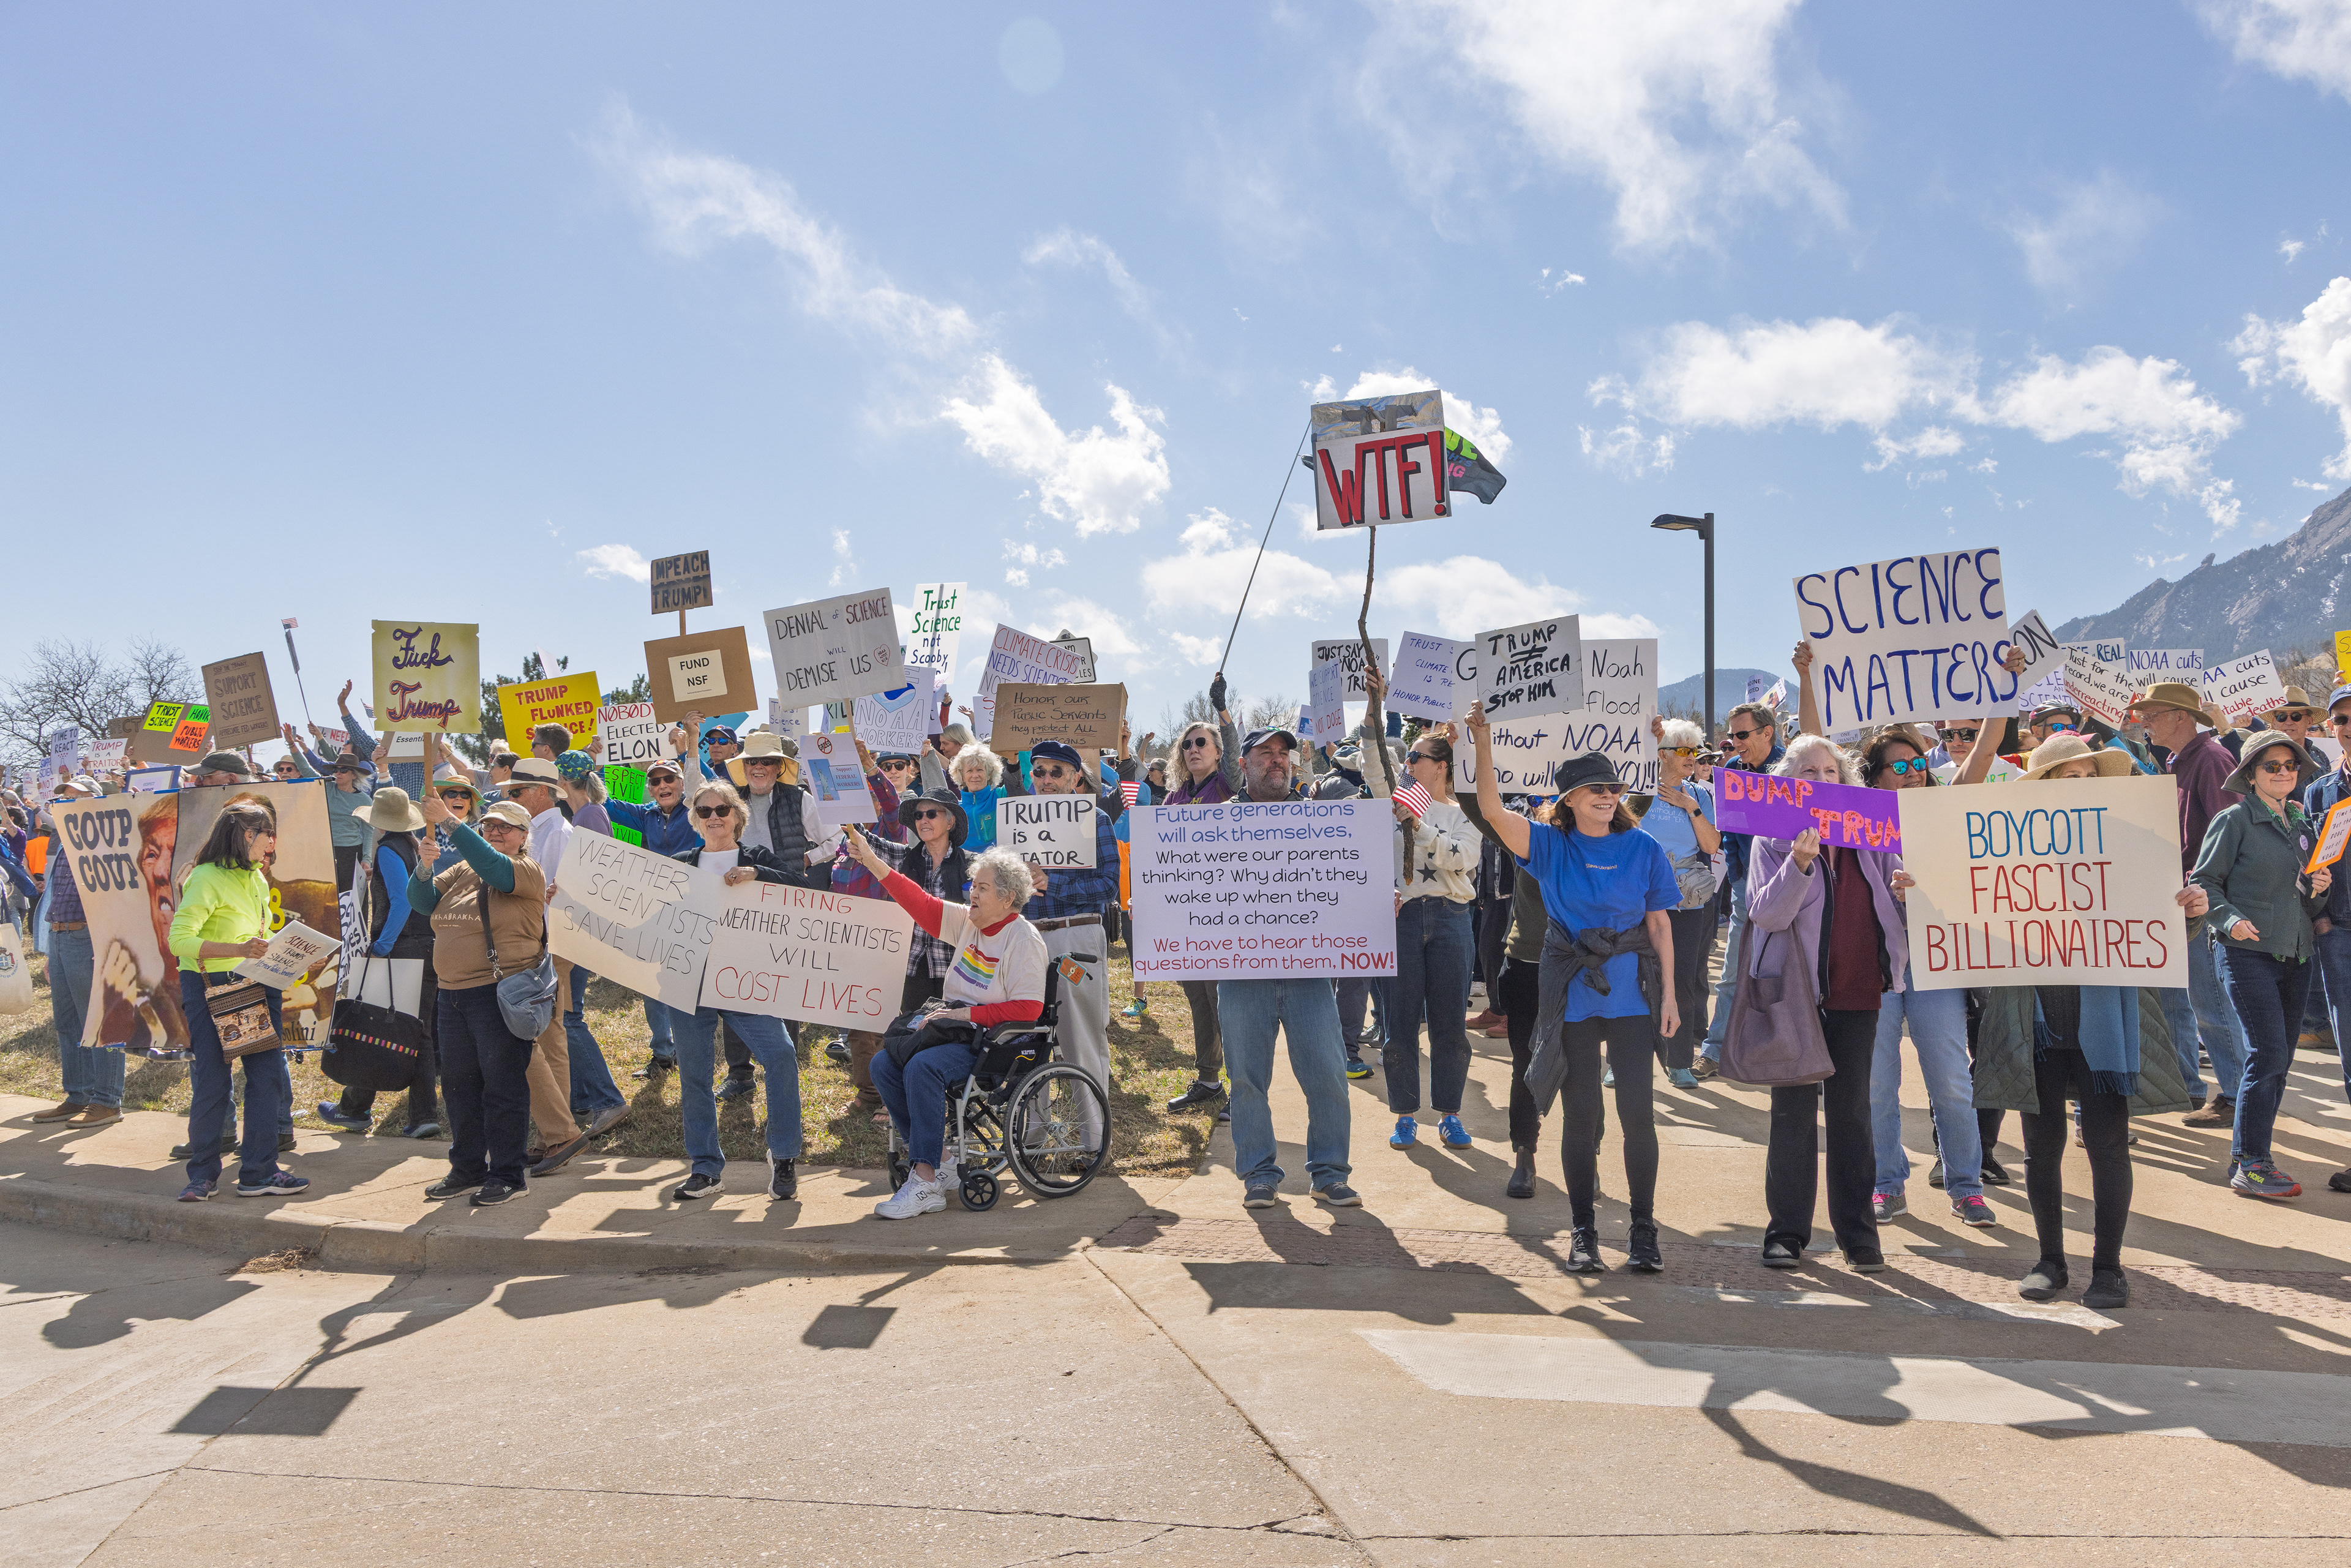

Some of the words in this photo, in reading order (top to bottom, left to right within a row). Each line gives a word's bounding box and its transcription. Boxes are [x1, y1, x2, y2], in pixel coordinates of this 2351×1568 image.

[1318, 430, 1447, 527] WTF!
[924, 589, 957, 610] Trust
[1797, 548, 2003, 639] SCIENCE
[775, 610, 829, 640] DENIAL
[833, 609, 839, 620] of
[846, 596, 889, 625] SCIENCE
[912, 612, 961, 634] Science
[392, 625, 455, 670] Fuck
[827, 647, 847, 655] WILL
[923, 634, 940, 647] not
[994, 628, 1046, 663] CLIMATE
[1046, 647, 1079, 674] CRISIS
[1410, 638, 1442, 651] TRUST
[1487, 624, 1558, 656] TRUMP
[910, 649, 948, 667] Scooby
[1318, 644, 1344, 661] JUST
[1343, 642, 1365, 658] SAY
[1592, 645, 1643, 678] Noah
[2096, 643, 2125, 662] REAL
[2130, 651, 2169, 670] NOAA
[2177, 650, 2202, 670] cuts
[680, 657, 710, 670] FUND
[786, 661, 838, 691] DEMISE
[850, 654, 871, 675] US
[988, 650, 1021, 678] NEEDS
[1319, 663, 1339, 685] SUPPORT
[1415, 659, 1449, 673] CLIMATE
[1496, 653, 1570, 686] AMERICA
[2068, 646, 2087, 667] Just
[2091, 661, 2109, 673] for
[2113, 672, 2134, 692] the
[2236, 655, 2270, 673] cuts
[214, 672, 257, 698] SUPPORT
[687, 675, 708, 687] NSF
[1824, 640, 2018, 727] MATTERS
[2065, 664, 2093, 687] record,
[2093, 680, 2106, 692] we
[2109, 688, 2129, 703] are
[2221, 674, 2268, 698] cause
[386, 680, 462, 730] Trump
[515, 685, 568, 705] TRUMP
[1313, 686, 1335, 708] SCIENCE
[1393, 688, 1420, 703] HONOR
[1485, 688, 1524, 714] STOP
[1528, 679, 1556, 702] HIM
[1585, 690, 1640, 715] flood
[2063, 678, 2124, 724] underreacting
[157, 705, 181, 716] TRUST
[220, 695, 264, 720] SCIENCE
[855, 698, 924, 730] NOAA
[2245, 696, 2287, 718] deaths
[148, 717, 176, 727] SCIENCE
[607, 722, 667, 740] ELECTED
[770, 715, 800, 725] Science
[1010, 724, 1029, 735] they
[1074, 723, 1098, 733] ALL
[1316, 716, 1324, 735] NOT
[1327, 708, 1341, 729] DOGE
[53, 732, 68, 743] TIME
[70, 728, 78, 738] TO
[175, 736, 201, 748] WORKERS
[182, 726, 205, 737] PUBLIC
[1562, 723, 1641, 754] NOAA
[54, 741, 75, 754] REACT
[92, 741, 122, 751] TRUMP
[607, 738, 661, 762] ELON
[88, 759, 122, 769] TRAITOR
[1523, 760, 1556, 787] will
[42, 778, 54, 789] NOT
[1724, 771, 1813, 808] DUMP
[1000, 800, 1093, 825] TRUMP
[1155, 807, 1224, 823] Future
[1230, 802, 1354, 822] generations
[1649, 806, 1675, 815] without
[64, 808, 133, 851] COUP
[1013, 828, 1027, 844] is
[1038, 830, 1056, 842] a
[1158, 827, 1186, 842] will
[1191, 825, 1228, 842] ask
[1231, 823, 1352, 841] themselves,
[1966, 807, 2107, 859] BOYCOTT
[1156, 850, 1201, 865] What
[1204, 851, 1248, 863] were
[1252, 850, 1284, 861] our
[1287, 847, 1360, 865] parents
[78, 853, 139, 893] COUP
[579, 837, 689, 900] WEATHER
[1142, 868, 1224, 885] thinking?
[1231, 868, 1269, 885] Why
[1273, 868, 1322, 882] didn't
[1326, 867, 1367, 885] they
[761, 883, 853, 913] FIRING
[1164, 889, 1212, 904] wake
[1217, 891, 1239, 906] up
[1243, 888, 1292, 904] when
[1297, 888, 1339, 906] they
[1970, 861, 2112, 914] FASCIST
[587, 873, 718, 945] SCIENTISTS
[1190, 911, 1223, 926] had
[1228, 913, 1240, 925] a
[1244, 910, 1319, 925] chance?
[563, 905, 626, 951] SAVE
[636, 931, 696, 974] LIVES
[719, 907, 790, 936] WEATHER
[797, 918, 902, 953] SCIENTISTS
[285, 936, 321, 955] SCIENCE
[1153, 938, 1180, 952] We
[1185, 937, 1233, 952] have
[1238, 935, 1258, 949] to
[1261, 934, 1308, 949] hear
[1311, 932, 1368, 948] those
[1926, 919, 2167, 972] BILLIONAIRES
[268, 953, 299, 968] SILENCE
[770, 943, 839, 971] WILL
[1134, 954, 1229, 975] questions
[1232, 953, 1278, 969] from
[1281, 954, 1337, 970] them,
[1341, 951, 1395, 970] NOW!
[716, 966, 789, 1002] COST
[802, 978, 882, 1016] LIVES
